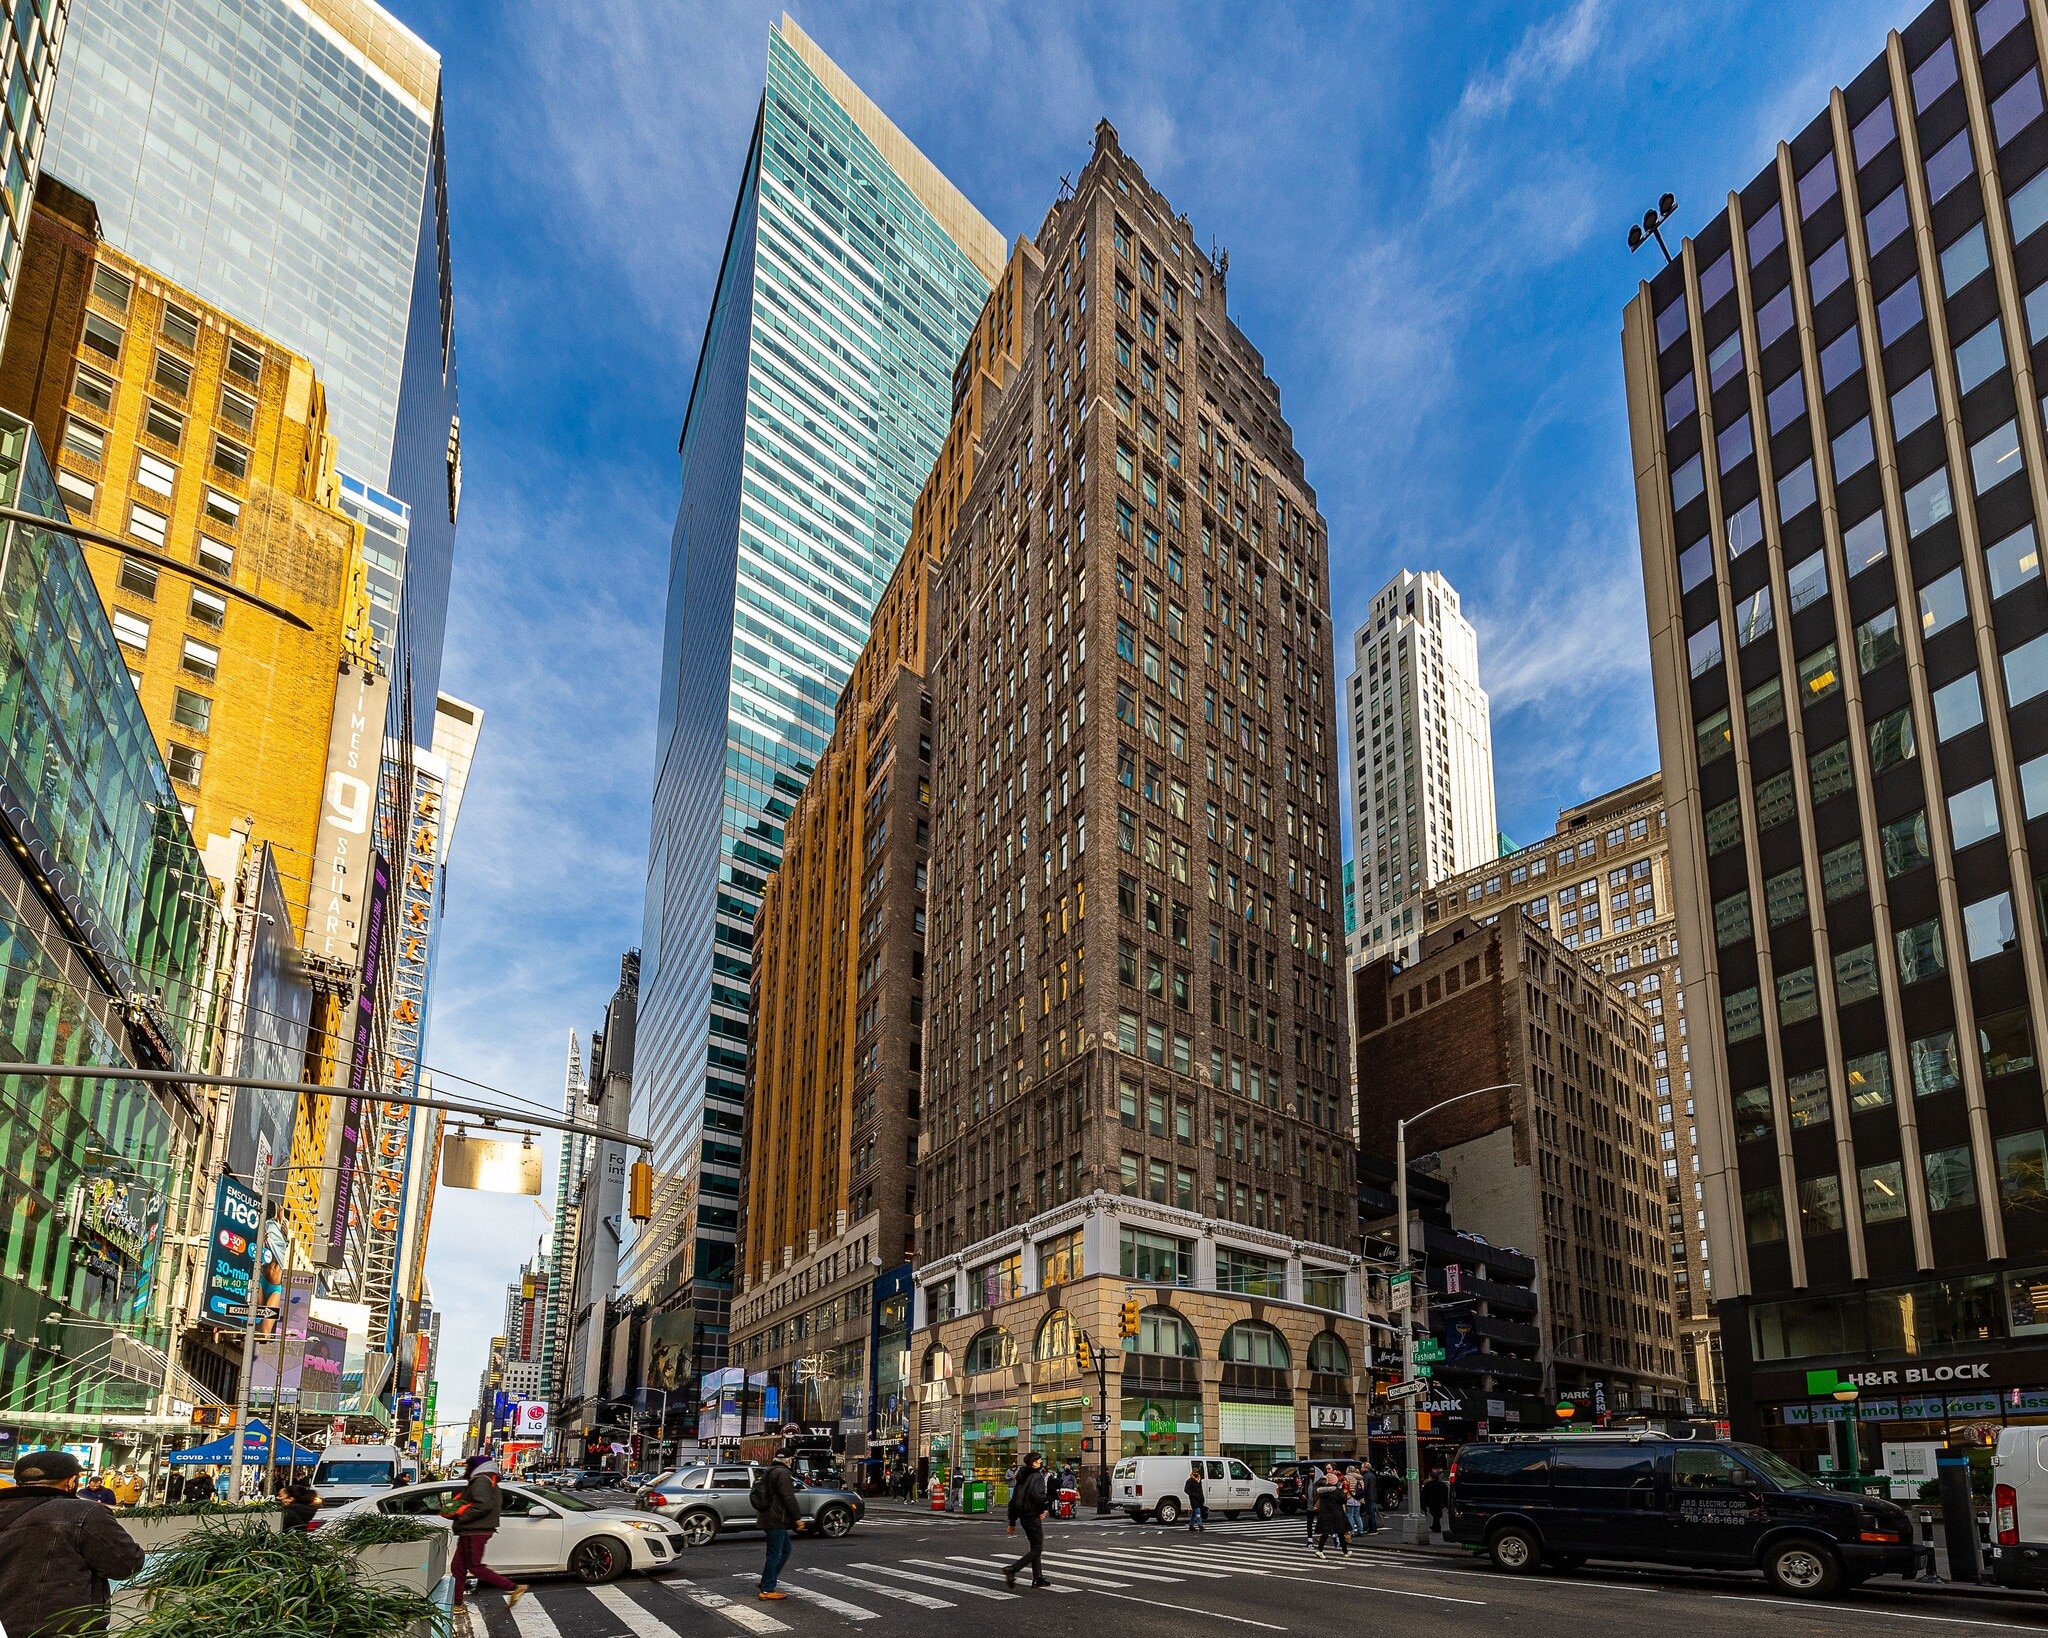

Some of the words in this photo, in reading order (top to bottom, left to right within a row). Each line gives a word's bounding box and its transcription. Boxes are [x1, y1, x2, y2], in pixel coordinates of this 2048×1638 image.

[347, 675, 367, 769] TIMES
[325, 769, 371, 835] 9
[405, 790, 439, 961] ERNST
[323, 836, 348, 955] SQUARE
[365, 897, 382, 986] PRETTYLITTLETHING
[226, 1185, 262, 1209] EMSCULPT
[223, 1194, 259, 1230] neo
[231, 1280, 241, 1288] 40
[303, 1354, 341, 1376] PINK
[1414, 1352, 1436, 1362] Fashion
[1848, 1370, 1898, 1387] H&R
[1905, 1363, 1991, 1383] BLOCK
[1390, 1387, 1402, 1397] ONE
[1408, 1383, 1421, 1392] WAY
[1561, 1390, 1590, 1400] PARK
[1594, 1382, 1606, 1414] PARK
[1422, 1399, 1462, 1412] PARK
[1790, 1406, 1819, 1420] We
[528, 1422, 543, 1430] LG
[1699, 1500, 1727, 1508] ELECTRIC
[1728, 1501, 1748, 1509] CORP.
[1684, 1515, 1745, 1525] 718-326-1666
